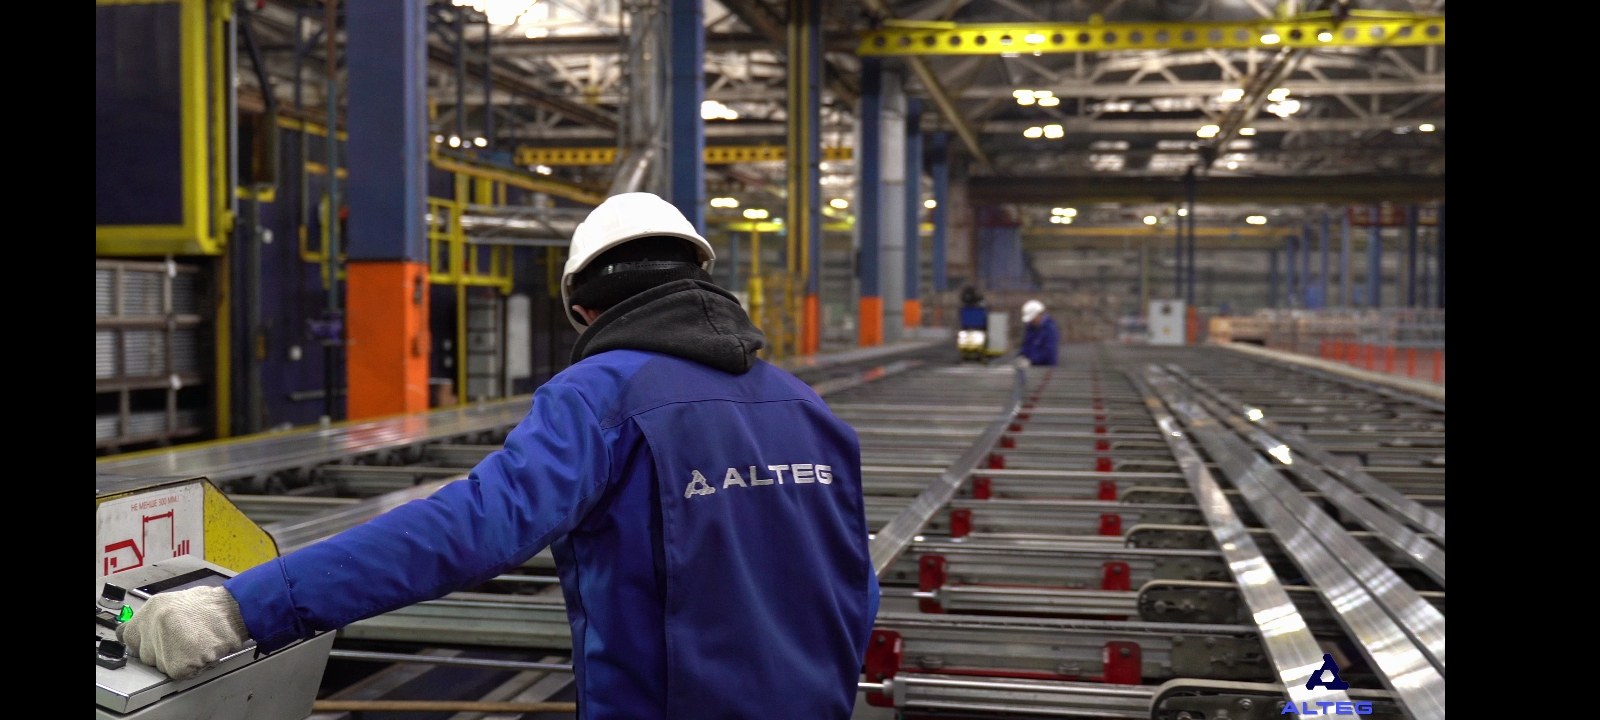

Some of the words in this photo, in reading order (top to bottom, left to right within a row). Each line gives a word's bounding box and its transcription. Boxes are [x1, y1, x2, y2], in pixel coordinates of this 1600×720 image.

[723, 464, 833, 489] ALTEG
[131, 503, 139, 511] НЕ
[158, 497, 167, 506] 300
